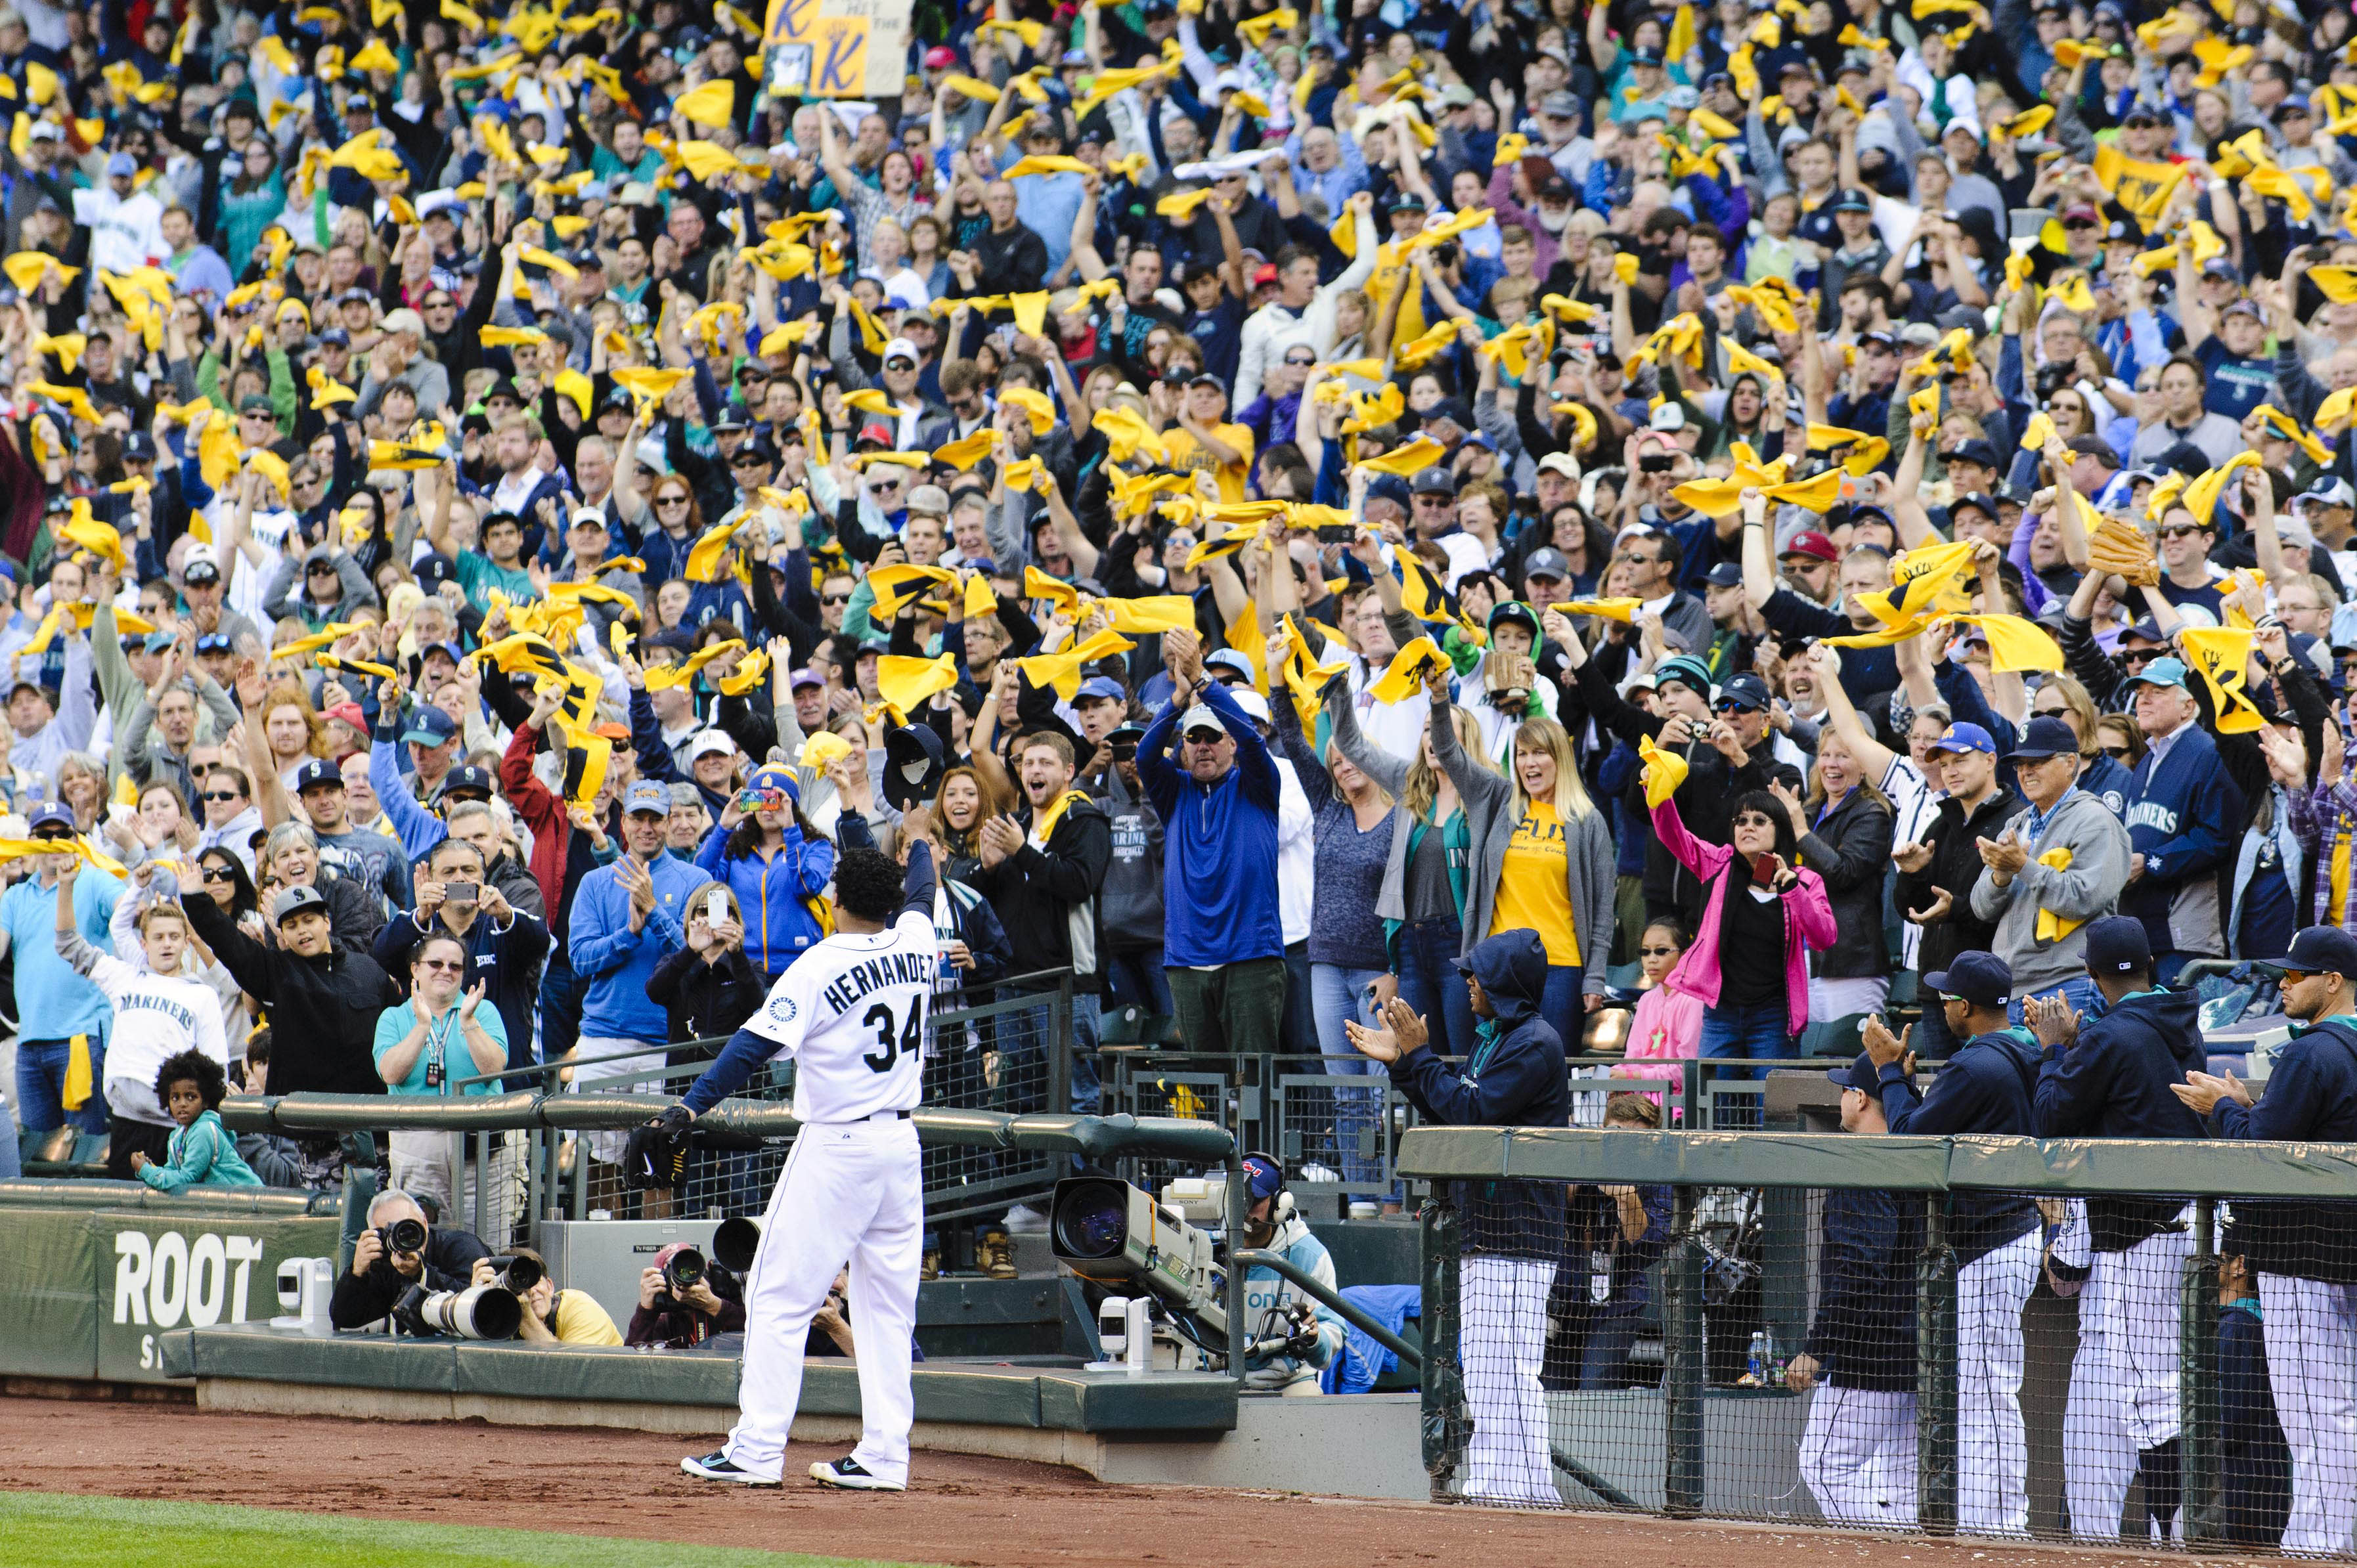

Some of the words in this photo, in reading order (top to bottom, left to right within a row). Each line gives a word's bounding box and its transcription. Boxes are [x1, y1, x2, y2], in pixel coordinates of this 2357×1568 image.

[819, 33, 864, 90] K
[418, 714, 428, 730] S
[2017, 724, 2029, 743] S
[311, 762, 321, 777] S
[465, 766, 475, 782] S
[2125, 798, 2176, 834] AINERS
[1449, 848, 1471, 868] IN
[294, 888, 305, 902] S
[475, 954, 497, 969] EBC
[824, 952, 933, 1016] HERNANDEZ
[120, 991, 194, 1031] MARINERS
[863, 993, 923, 1074] 34
[113, 1230, 263, 1328] ROOT
[1178, 1262, 1190, 1278] 72
